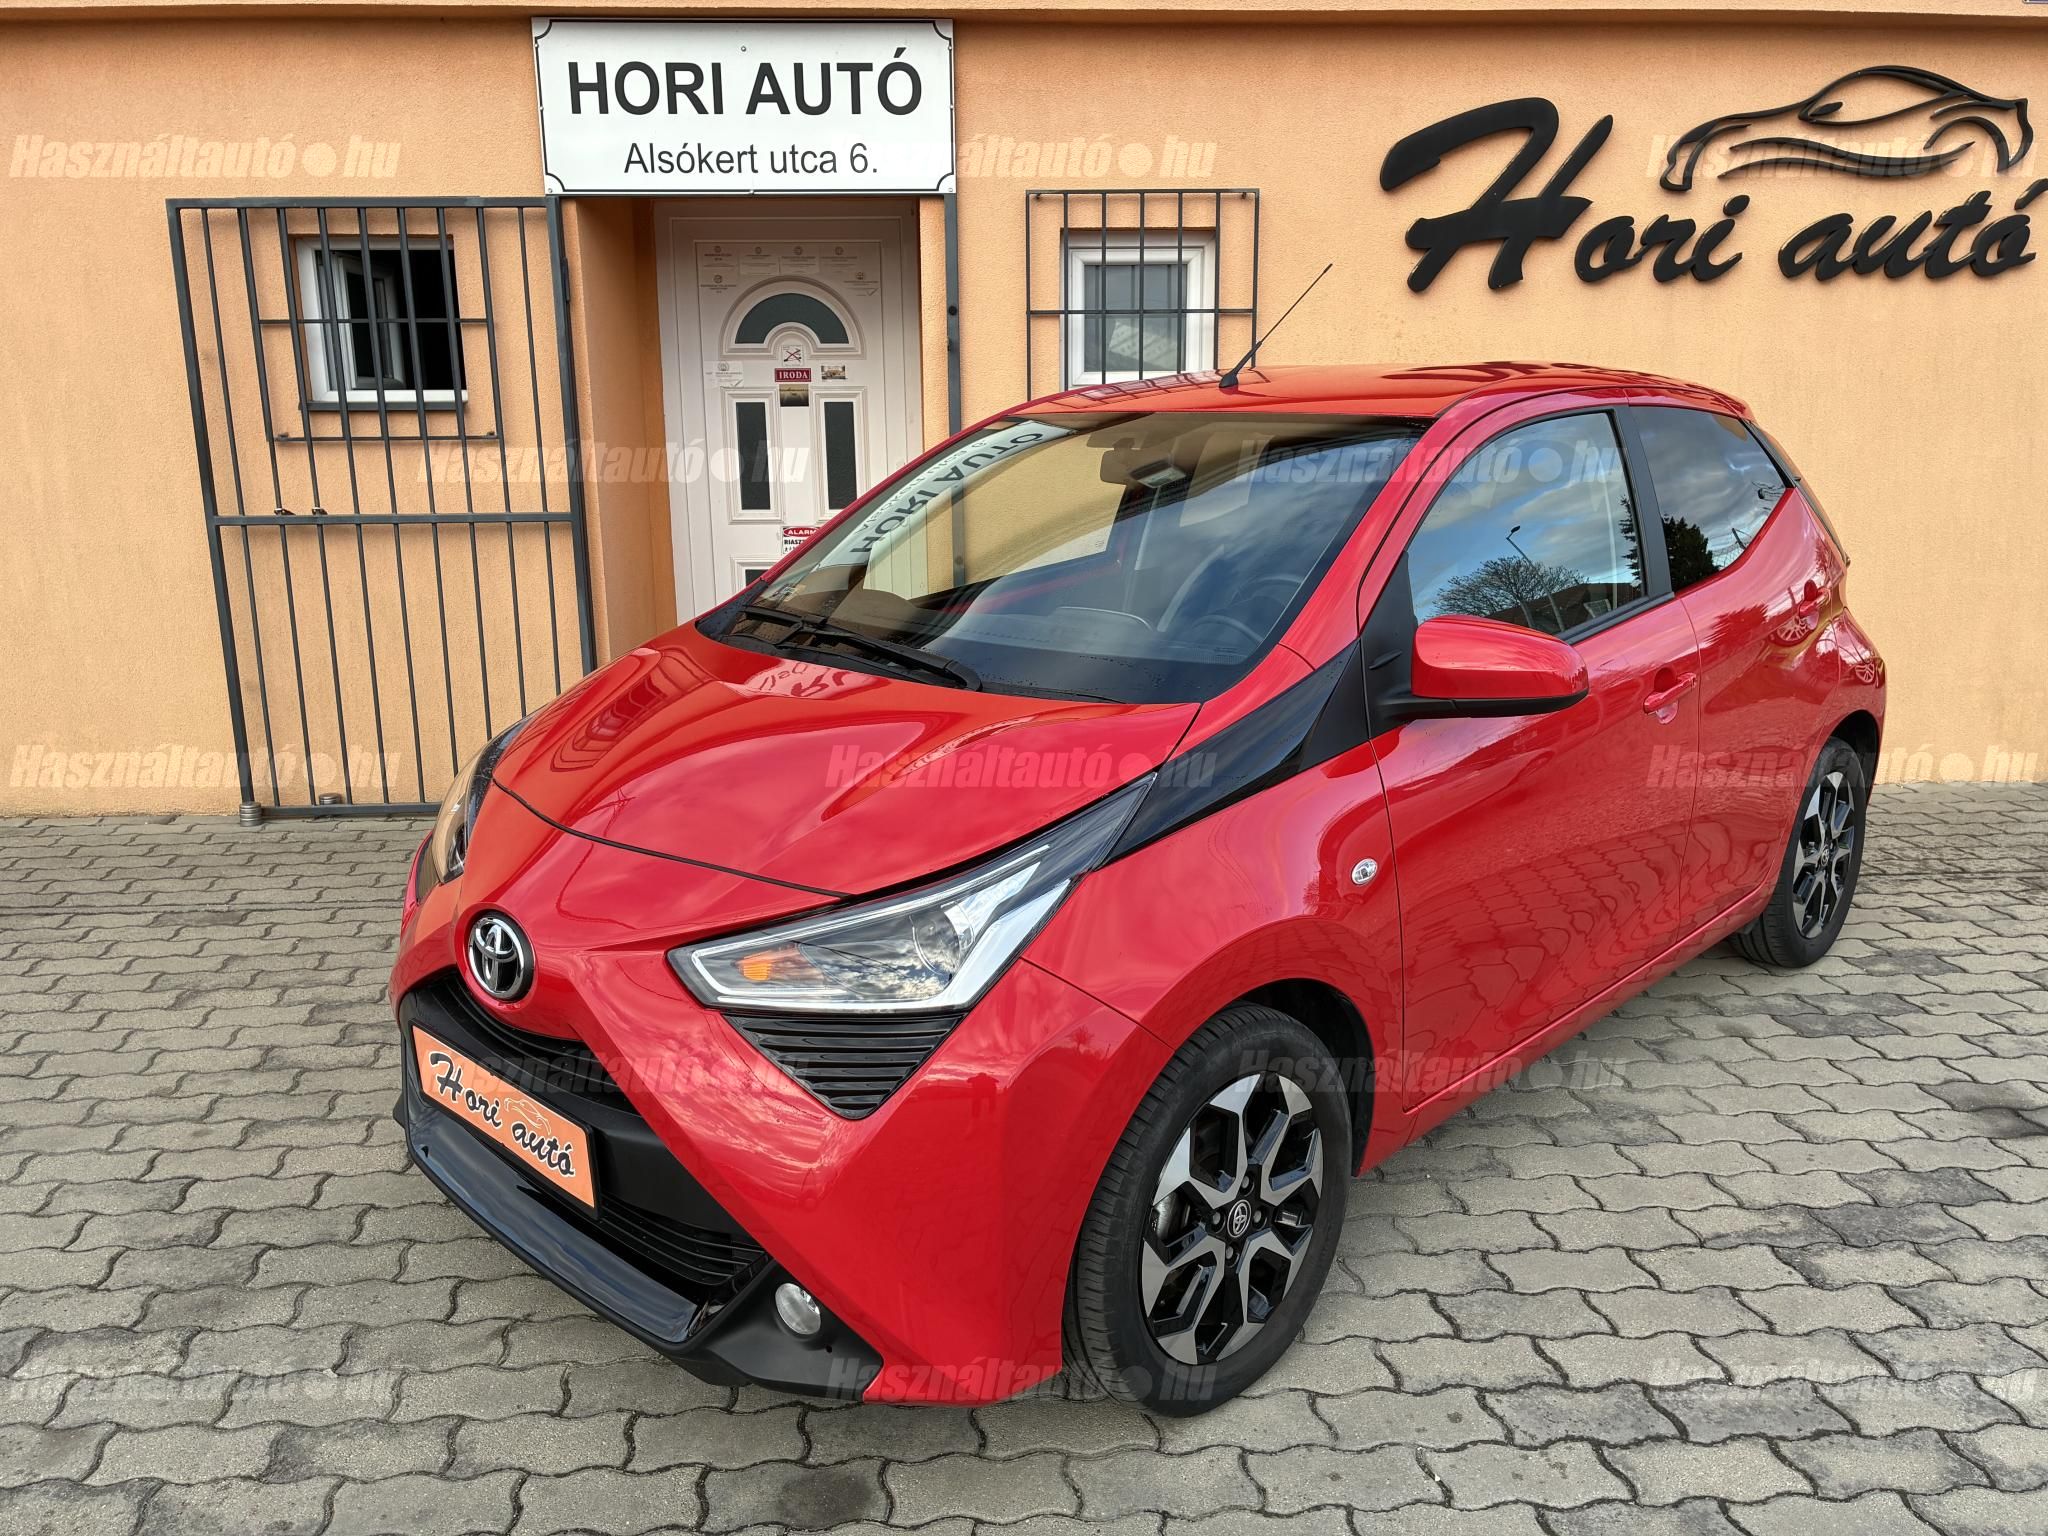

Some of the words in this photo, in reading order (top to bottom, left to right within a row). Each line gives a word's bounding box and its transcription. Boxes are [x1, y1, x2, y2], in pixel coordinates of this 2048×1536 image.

[567, 61, 724, 116] HORI
[745, 47, 923, 116] AUTÓ
[624, 142, 758, 176] Alsókert
[769, 147, 838, 176] utca
[849, 143, 878, 176] 6.
[1380, 97, 1750, 293] Hori
[1777, 178, 2048, 282] autó
[779, 370, 809, 380] IRODA
[429, 1051, 502, 1128] Hori
[512, 1120, 575, 1177] autó
